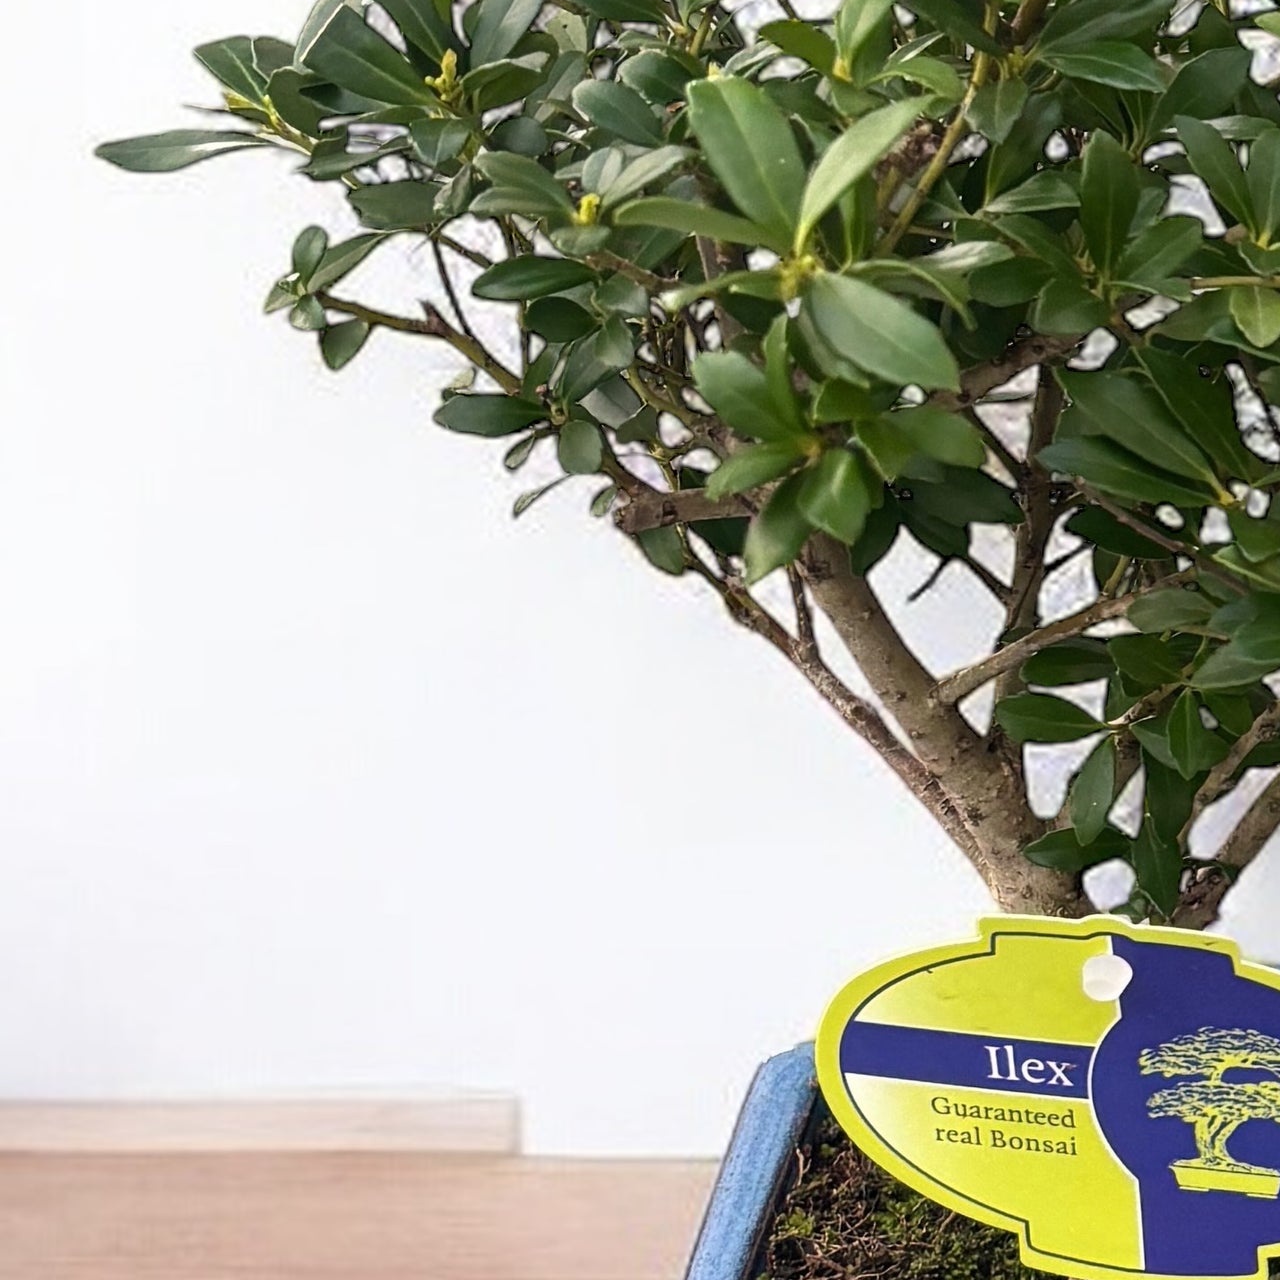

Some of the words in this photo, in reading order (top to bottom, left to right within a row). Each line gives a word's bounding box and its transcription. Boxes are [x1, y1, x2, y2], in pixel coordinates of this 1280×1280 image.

[984, 1045, 1074, 1087] Ilex
[930, 1096, 1077, 1129] Guaranteed
[935, 1126, 982, 1147] real
[990, 1130, 1078, 1156] Bonsai
